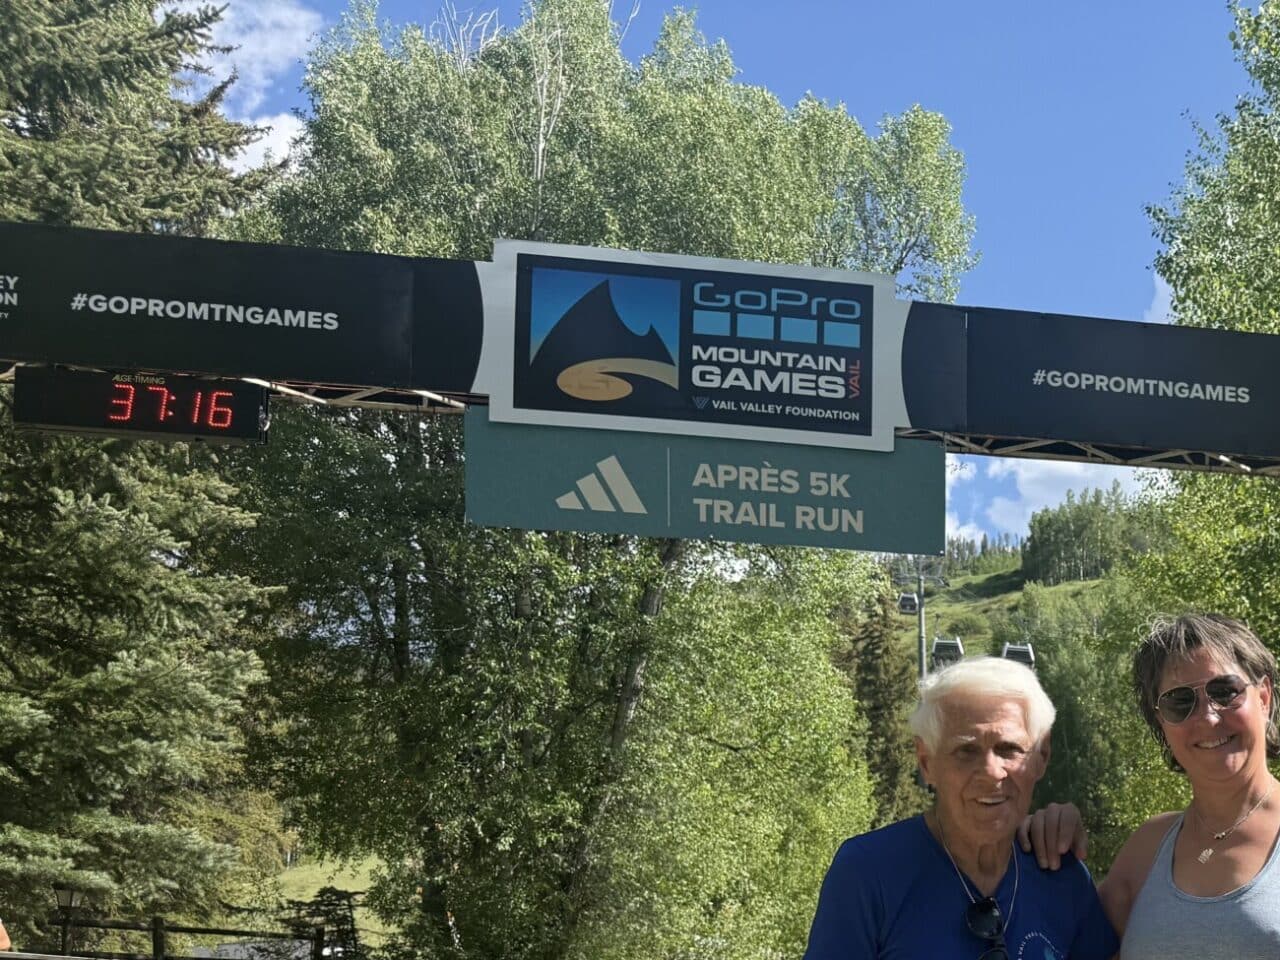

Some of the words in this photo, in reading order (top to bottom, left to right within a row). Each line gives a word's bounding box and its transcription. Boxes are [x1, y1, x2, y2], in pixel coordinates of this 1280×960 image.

[71, 293, 339, 330] #GOPROMTNGAMES
[693, 282, 862, 319] GoPro
[692, 345, 846, 373] MOUNTAIN
[691, 364, 846, 399] GAMES
[849, 359, 861, 399] VAIL
[1032, 369, 1250, 404] #GOPROMTNGAMES
[109, 384, 234, 428] 37:16
[712, 400, 737, 411] VAIL
[740, 402, 783, 415] VALLEY
[785, 405, 860, 421] FOUNDATION
[692, 460, 800, 494] APRÈS
[809, 471, 851, 499] 5K
[693, 498, 785, 528] TRAIL
[796, 504, 864, 534] RUN
